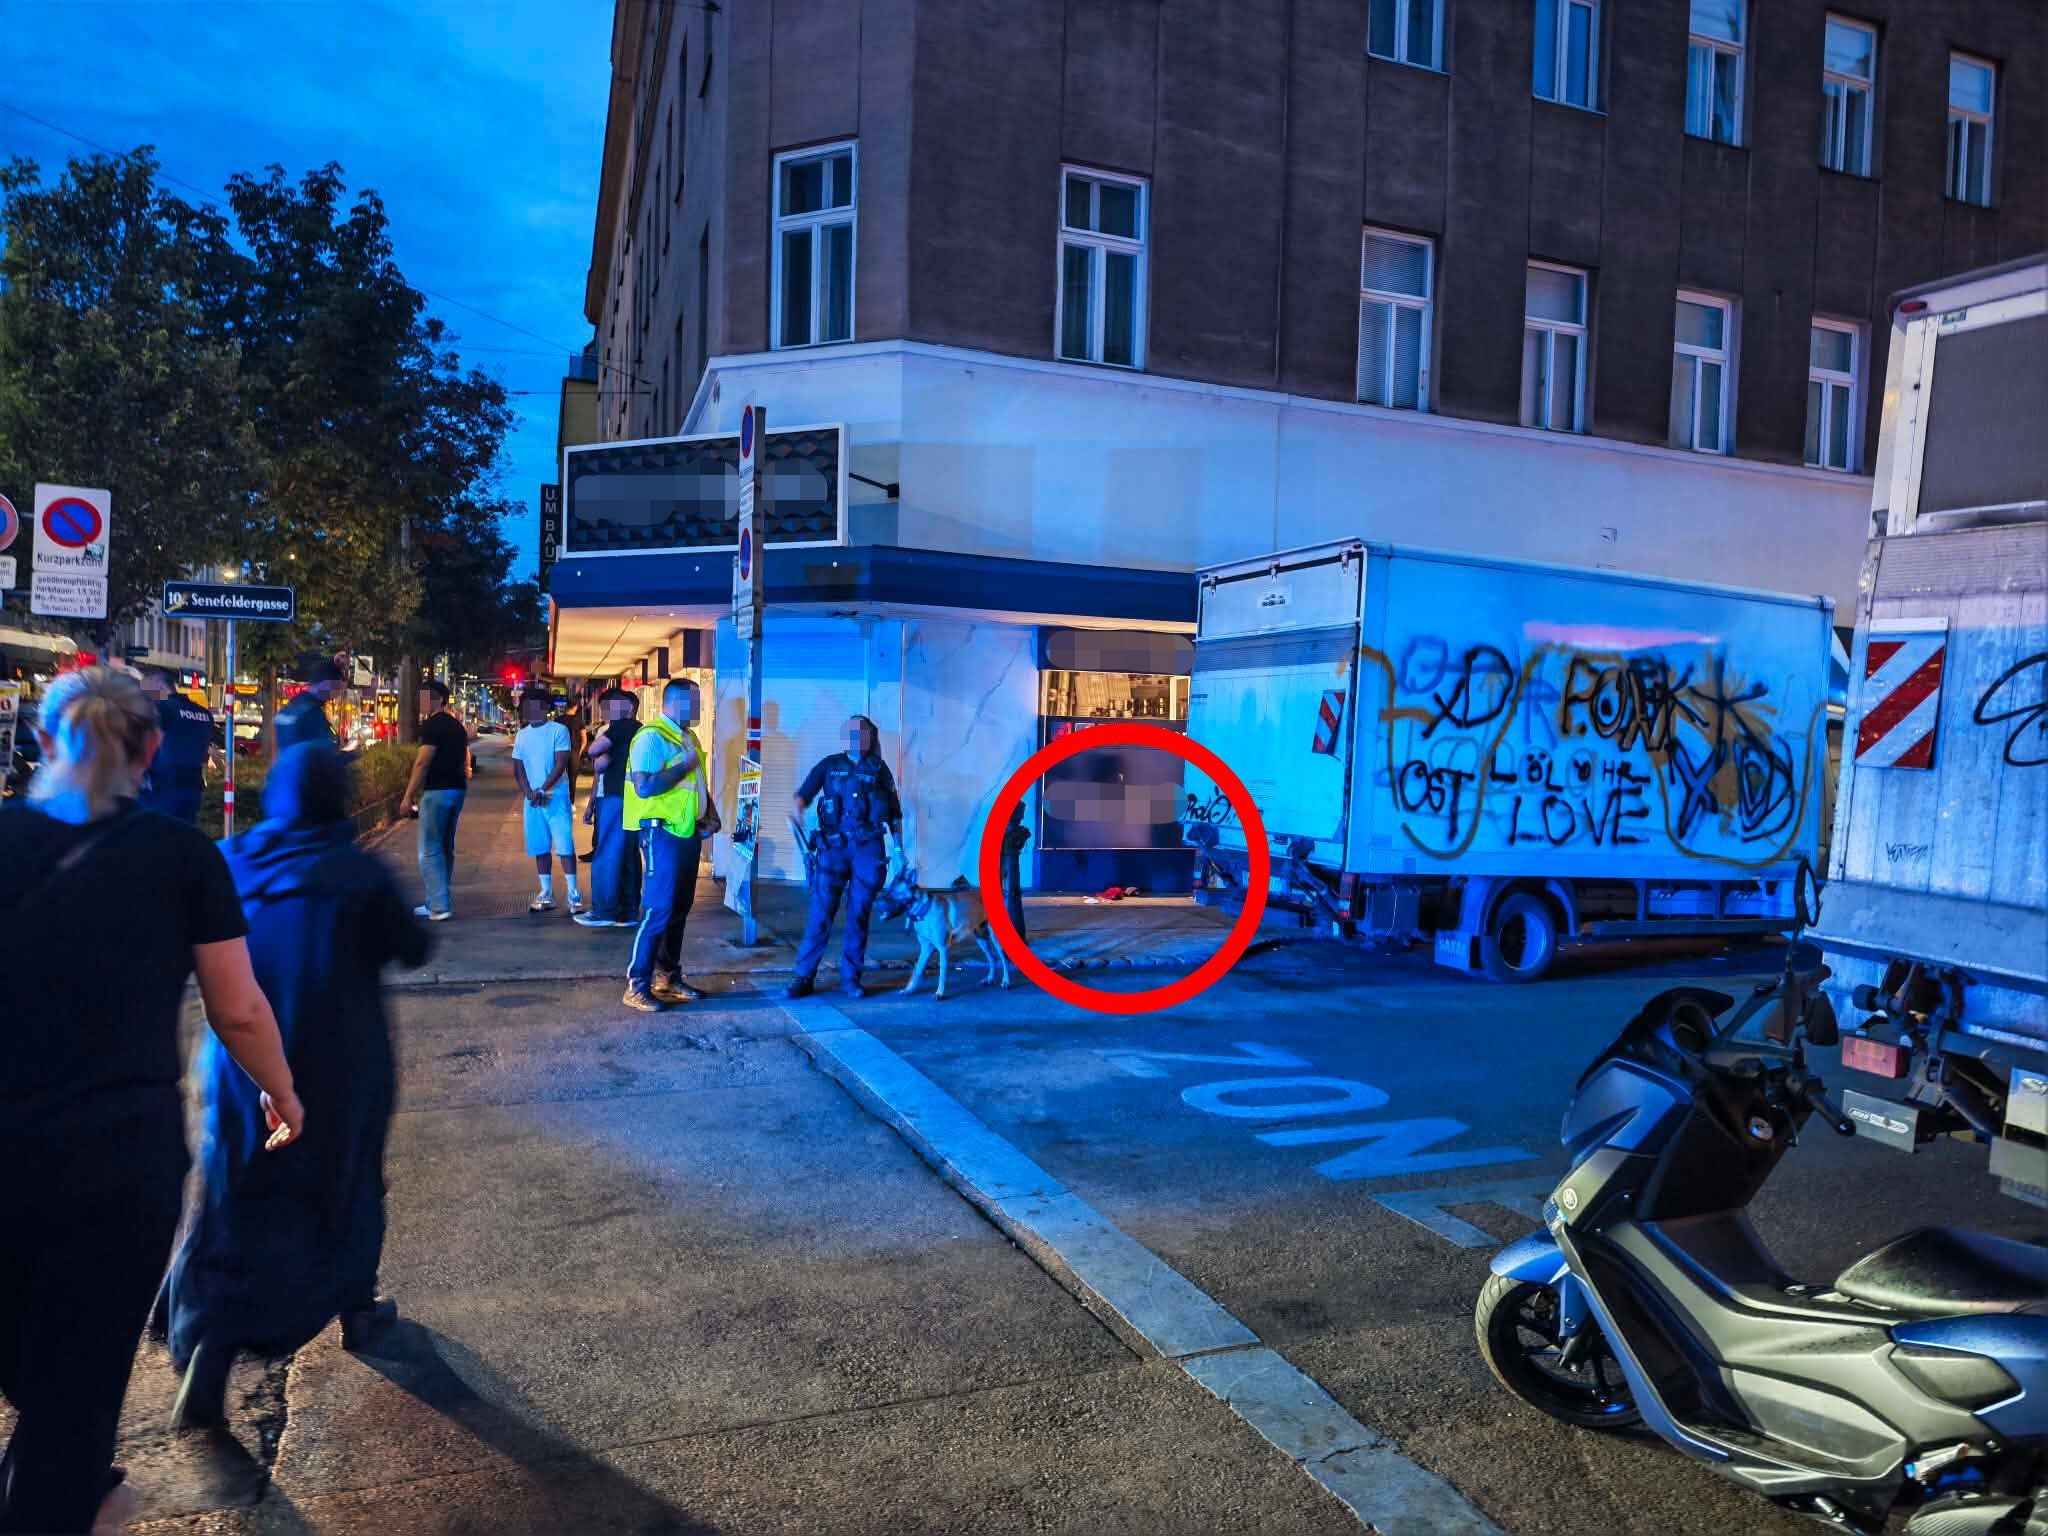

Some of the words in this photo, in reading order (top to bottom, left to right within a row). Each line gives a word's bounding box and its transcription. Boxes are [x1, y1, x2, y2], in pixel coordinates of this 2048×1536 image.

[191, 593, 289, 612] Senefeldergasse
[179, 709, 210, 722] POLIZEI
[1507, 787, 1650, 846] LOVE
